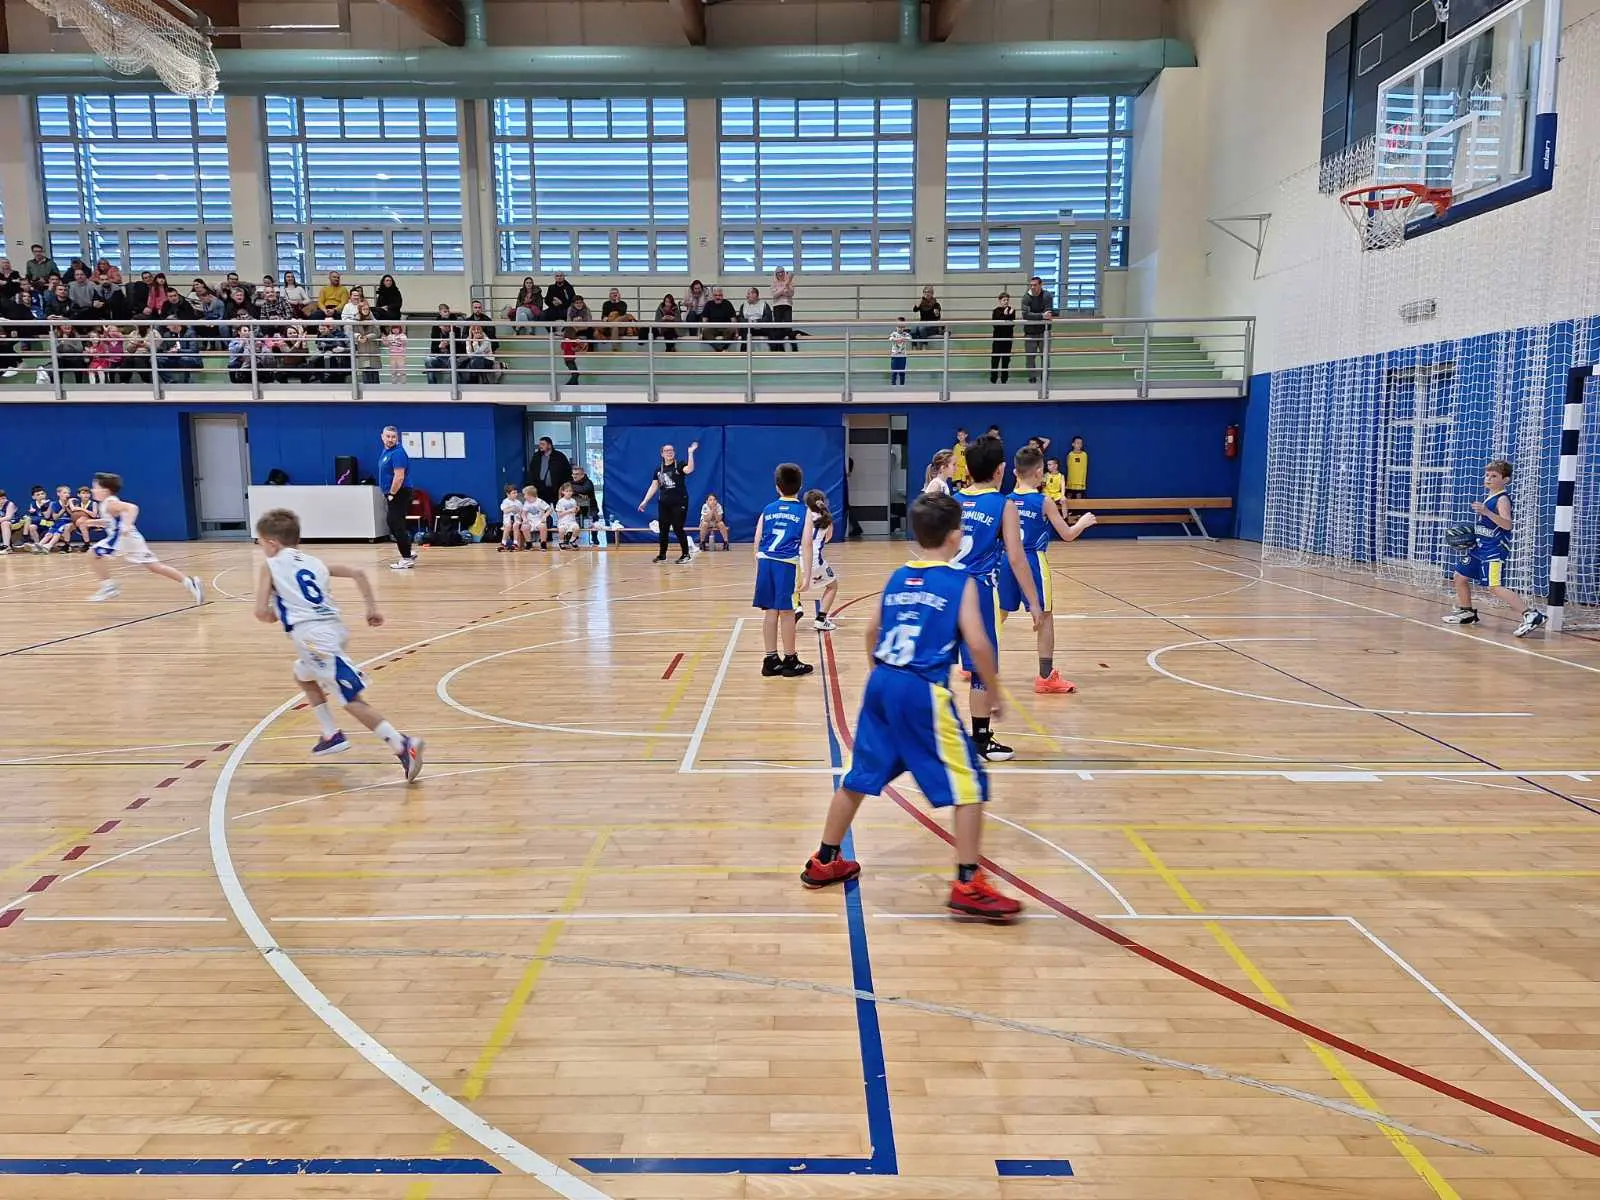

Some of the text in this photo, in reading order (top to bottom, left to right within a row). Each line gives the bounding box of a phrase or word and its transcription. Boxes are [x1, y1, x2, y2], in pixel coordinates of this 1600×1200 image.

[1543, 140, 1552, 171] elan
[768, 528, 786, 552] 7
[295, 568, 324, 605] 6
